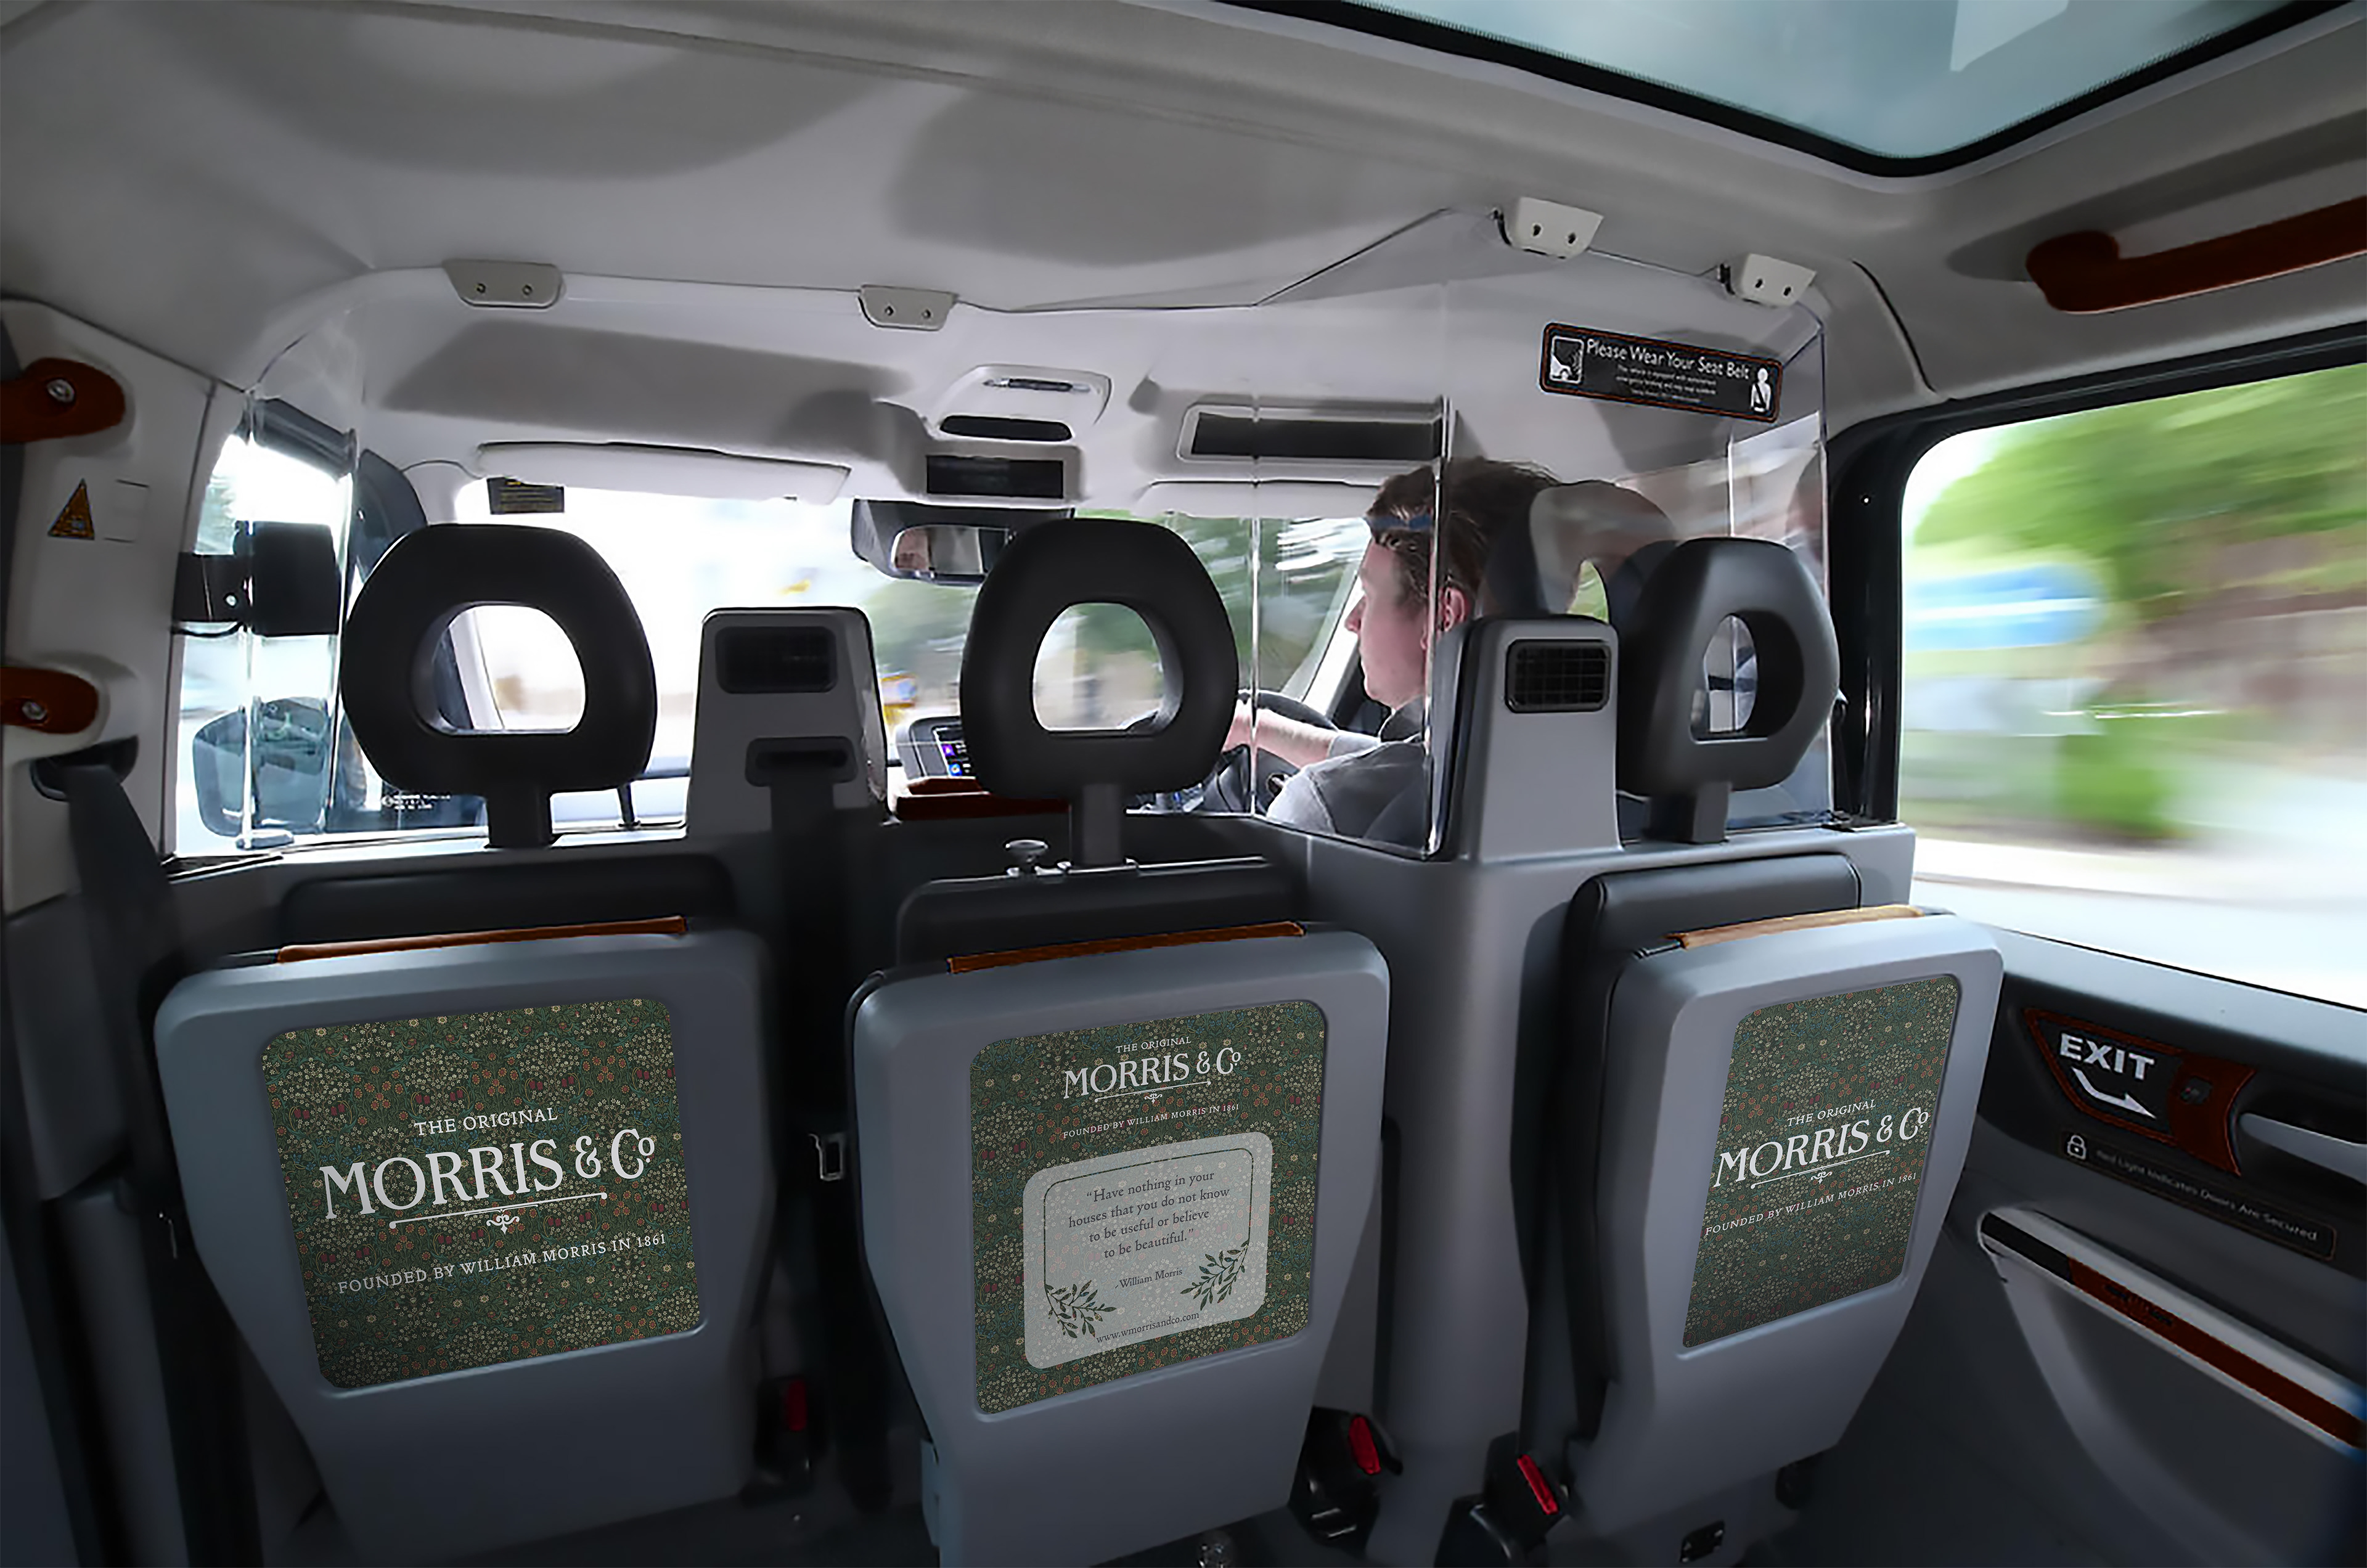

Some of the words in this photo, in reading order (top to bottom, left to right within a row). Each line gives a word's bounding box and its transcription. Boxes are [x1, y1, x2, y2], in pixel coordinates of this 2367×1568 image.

[1587, 339, 1627, 360] Please
[1630, 346, 1664, 365] Wear
[1666, 351, 1695, 369] Your
[1698, 357, 1723, 375] Seat
[1116, 1043, 1138, 1053] THE
[1141, 1036, 1192, 1050] ORIGINAL
[2059, 1033, 2155, 1080] EXIT
[1063, 1053, 1190, 1099] MORRIS
[1196, 1051, 1211, 1074] &
[414, 1118, 456, 1136] THE
[463, 1108, 558, 1130] ORIGINAL
[1063, 1123, 1110, 1138] FOUNDED
[1113, 1121, 1125, 1129] BY
[1126, 1113, 1168, 1126] WILLIAM
[1171, 1108, 1206, 1119] MORRIS
[1787, 1113, 1813, 1127] THE
[1817, 1100, 1877, 1119] ORIGINAL
[1713, 1119, 1870, 1188] MORRIS
[1876, 1115, 1893, 1143] &
[319, 1139, 563, 1220] MORRIS
[575, 1135, 601, 1178] &
[1128, 1178, 1172, 1194] nothing
[1175, 1175, 1185, 1186] in
[1189, 1172, 1214, 1186] your
[1068, 1212, 1107, 1228] houses
[1111, 1205, 1134, 1217] that
[1137, 1201, 1157, 1215] you
[1161, 1196, 1175, 1207] do
[1178, 1193, 1196, 1204] not
[1200, 1189, 1230, 1200] know
[1705, 1214, 1764, 1236] FOUNDED
[1767, 1208, 1783, 1219] BY
[1786, 1194, 1834, 1214] WILLIAM
[1838, 1182, 1879, 1199] MORRIS
[1882, 1178, 1895, 1188] IN
[1898, 1172, 1916, 1183] 1861
[1089, 1233, 1100, 1242] to
[1103, 1227, 1116, 1239] be
[1121, 1217, 1153, 1235] useful
[1158, 1218, 1169, 1227] or
[1172, 1210, 1209, 1225] believe
[2238, 1204, 2260, 1219] Are
[2263, 1213, 2317, 1241] Secured
[338, 1270, 427, 1294] FOUNDED
[434, 1265, 456, 1279] BY
[460, 1252, 536, 1275] WILLIAM
[543, 1242, 607, 1262] MORRIS
[613, 1238, 631, 1252] IN
[637, 1233, 666, 1248] 1861
[1104, 1249, 1114, 1258] to
[1118, 1243, 1131, 1255] be
[1155, 1268, 1183, 1280] Morris
[1096, 1313, 1200, 1343] www.wmorrisandco.com
